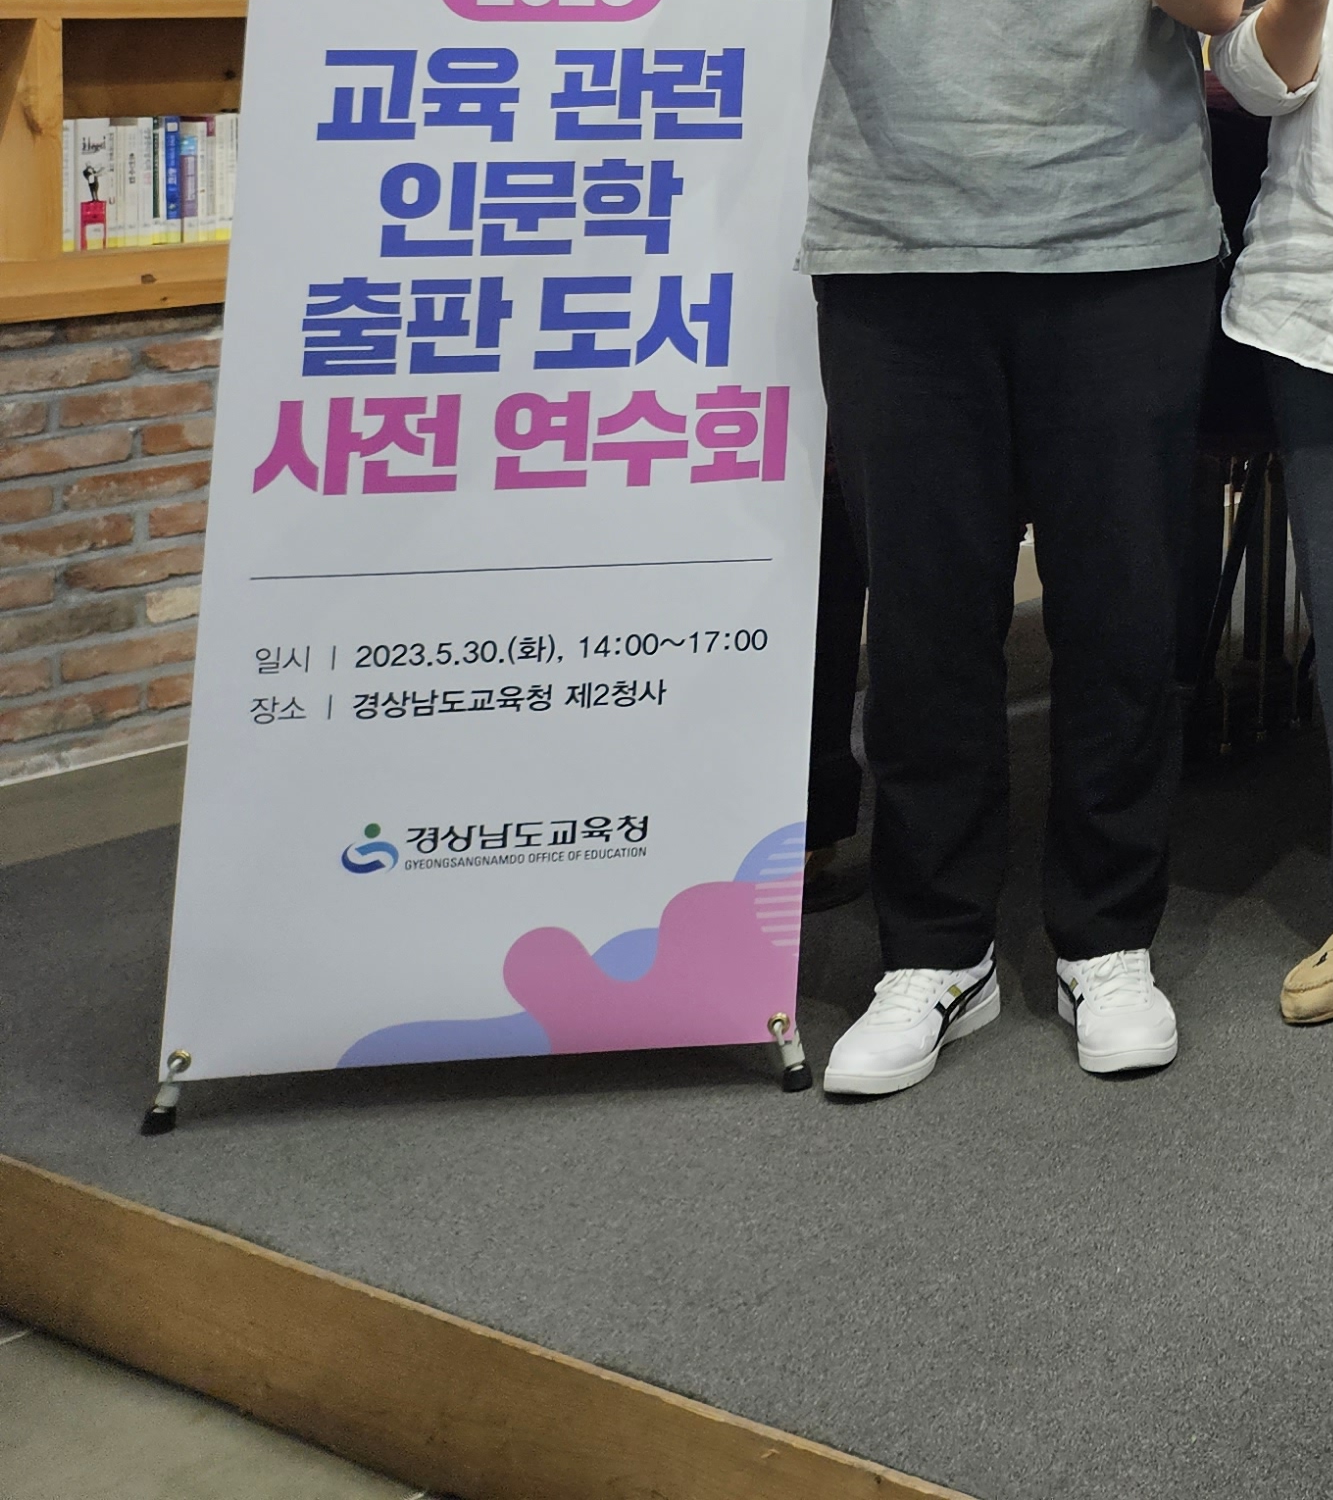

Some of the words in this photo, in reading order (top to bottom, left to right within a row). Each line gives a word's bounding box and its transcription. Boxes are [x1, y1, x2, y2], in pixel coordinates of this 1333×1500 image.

[316, 46, 520, 143] 교육
[550, 47, 746, 141] 관련
[379, 158, 685, 259] 인문학
[301, 276, 514, 377] 출판
[533, 272, 734, 370] 도서
[252, 393, 462, 496] 사전
[493, 384, 791, 491] 연수회
[254, 645, 311, 676] 일시
[354, 635, 565, 671] 2023.5.30.(화),
[249, 696, 308, 725] 장소
[351, 685, 554, 721] 경상남도교육청
[564, 678, 668, 710] 제2청사
[403, 852, 526, 872] GYEONGSANGNAMDO
[527, 850, 566, 864] OFFICE
[567, 849, 583, 862] OF
[584, 845, 648, 861] EDUCATION
[405, 814, 651, 855] 경상남도교육청
